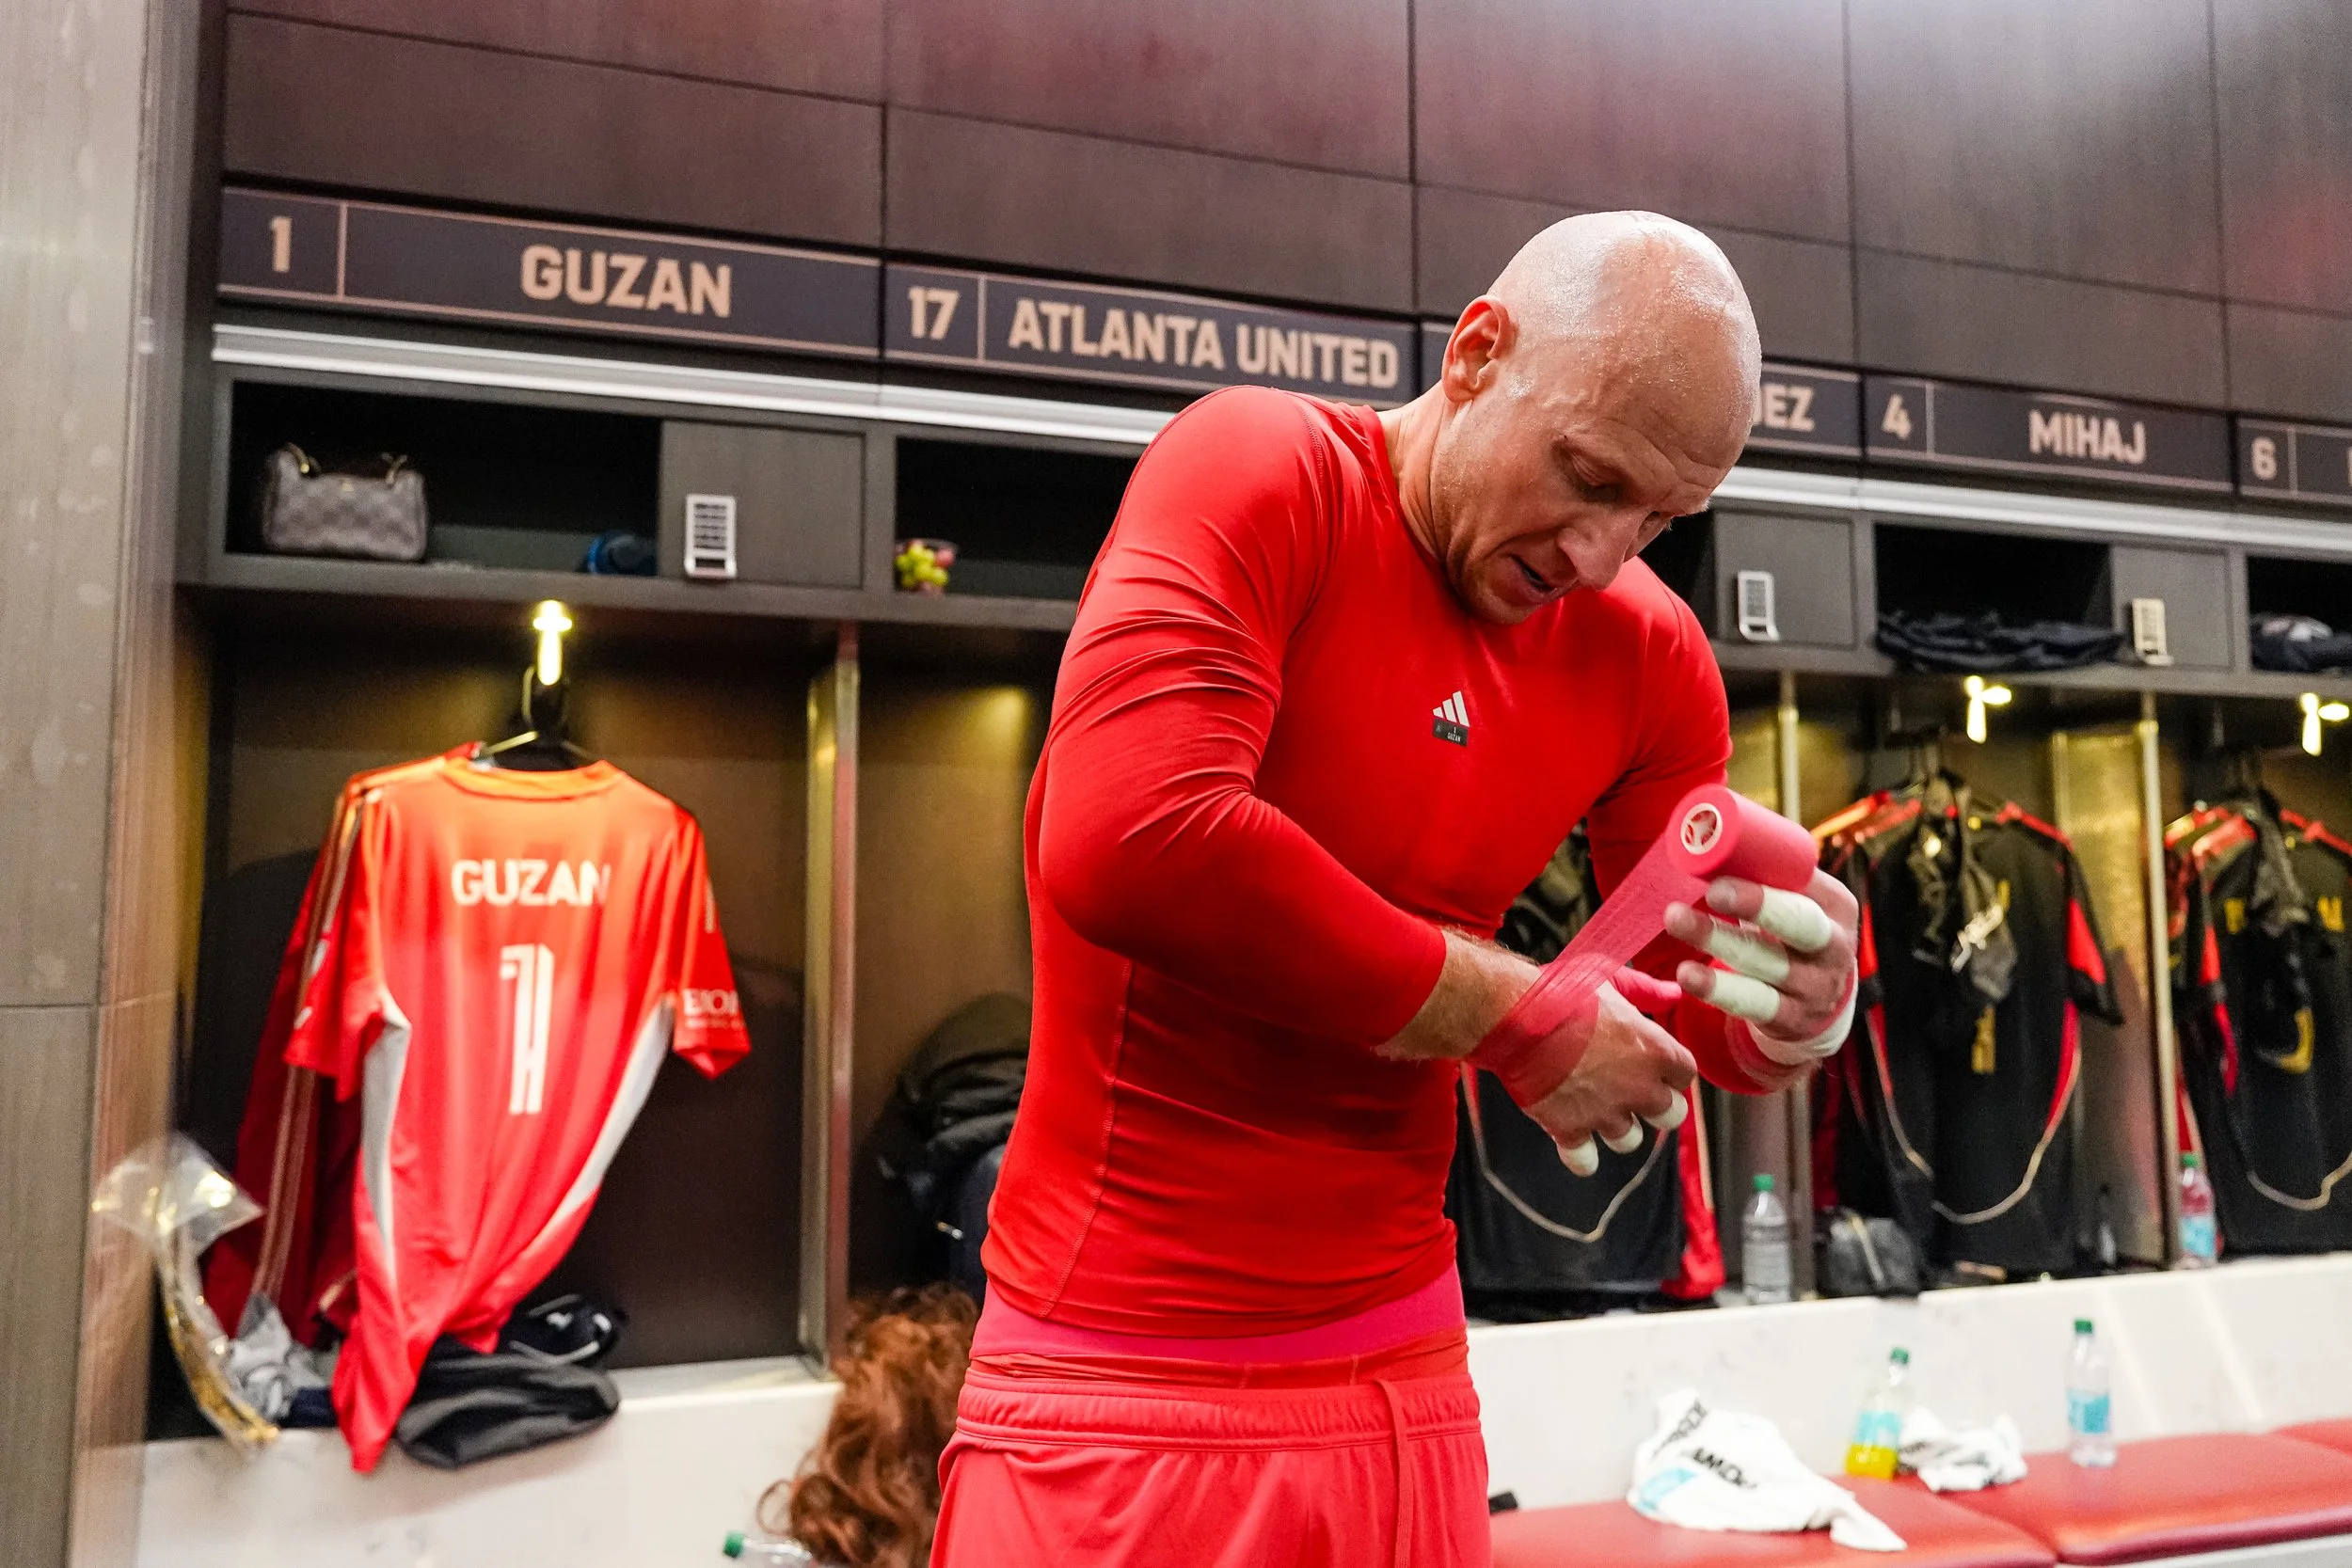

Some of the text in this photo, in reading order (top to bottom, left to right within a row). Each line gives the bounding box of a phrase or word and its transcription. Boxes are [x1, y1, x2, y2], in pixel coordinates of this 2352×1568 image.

[270, 215, 733, 318] 1 GUZAN
[908, 286, 1399, 390] 17 ATLANTA UNITED
[1881, 393, 2147, 465] 4 MIHAJ
[2250, 436, 2278, 481] 6
[1447, 732, 1461, 742] GUZAN
[450, 858, 612, 908] GUZAN
